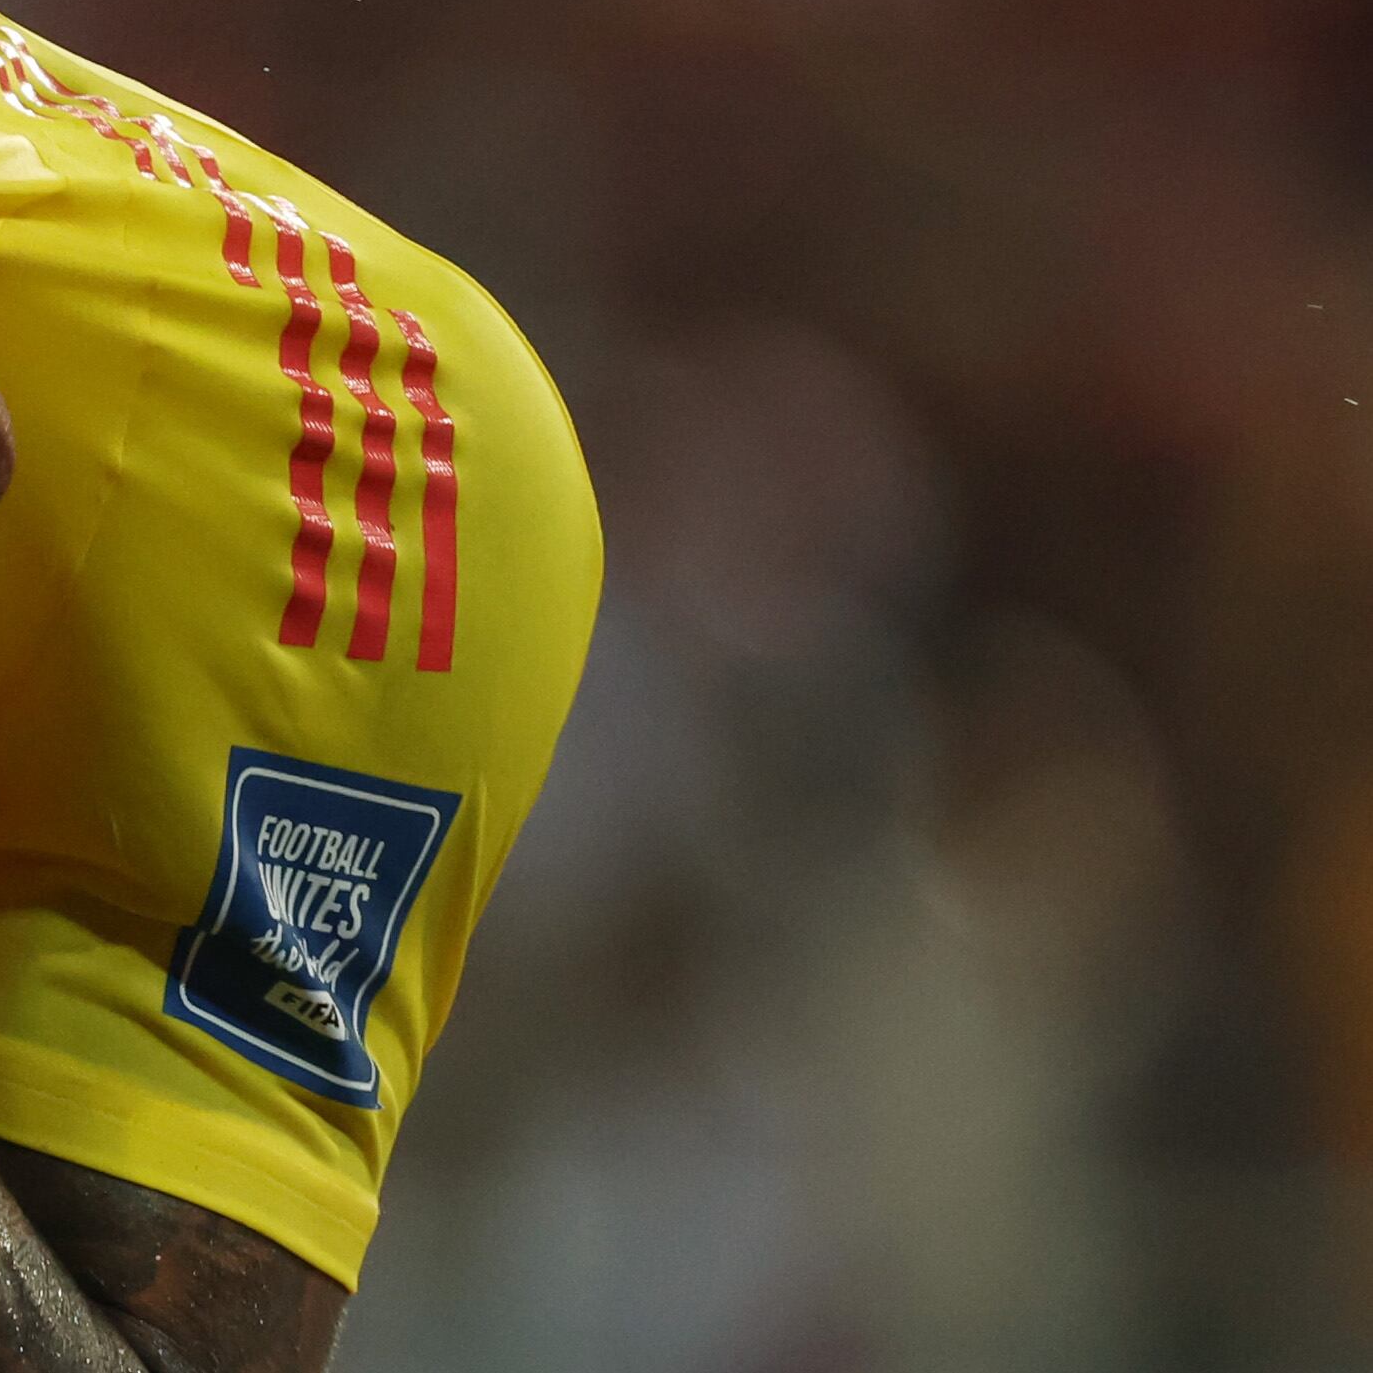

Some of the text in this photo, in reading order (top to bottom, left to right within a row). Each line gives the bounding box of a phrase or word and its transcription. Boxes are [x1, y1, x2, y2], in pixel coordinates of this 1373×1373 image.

[257, 814, 385, 881] FOOTBALL
[258, 861, 370, 940] UNITES
[281, 992, 340, 1029] FIFA
